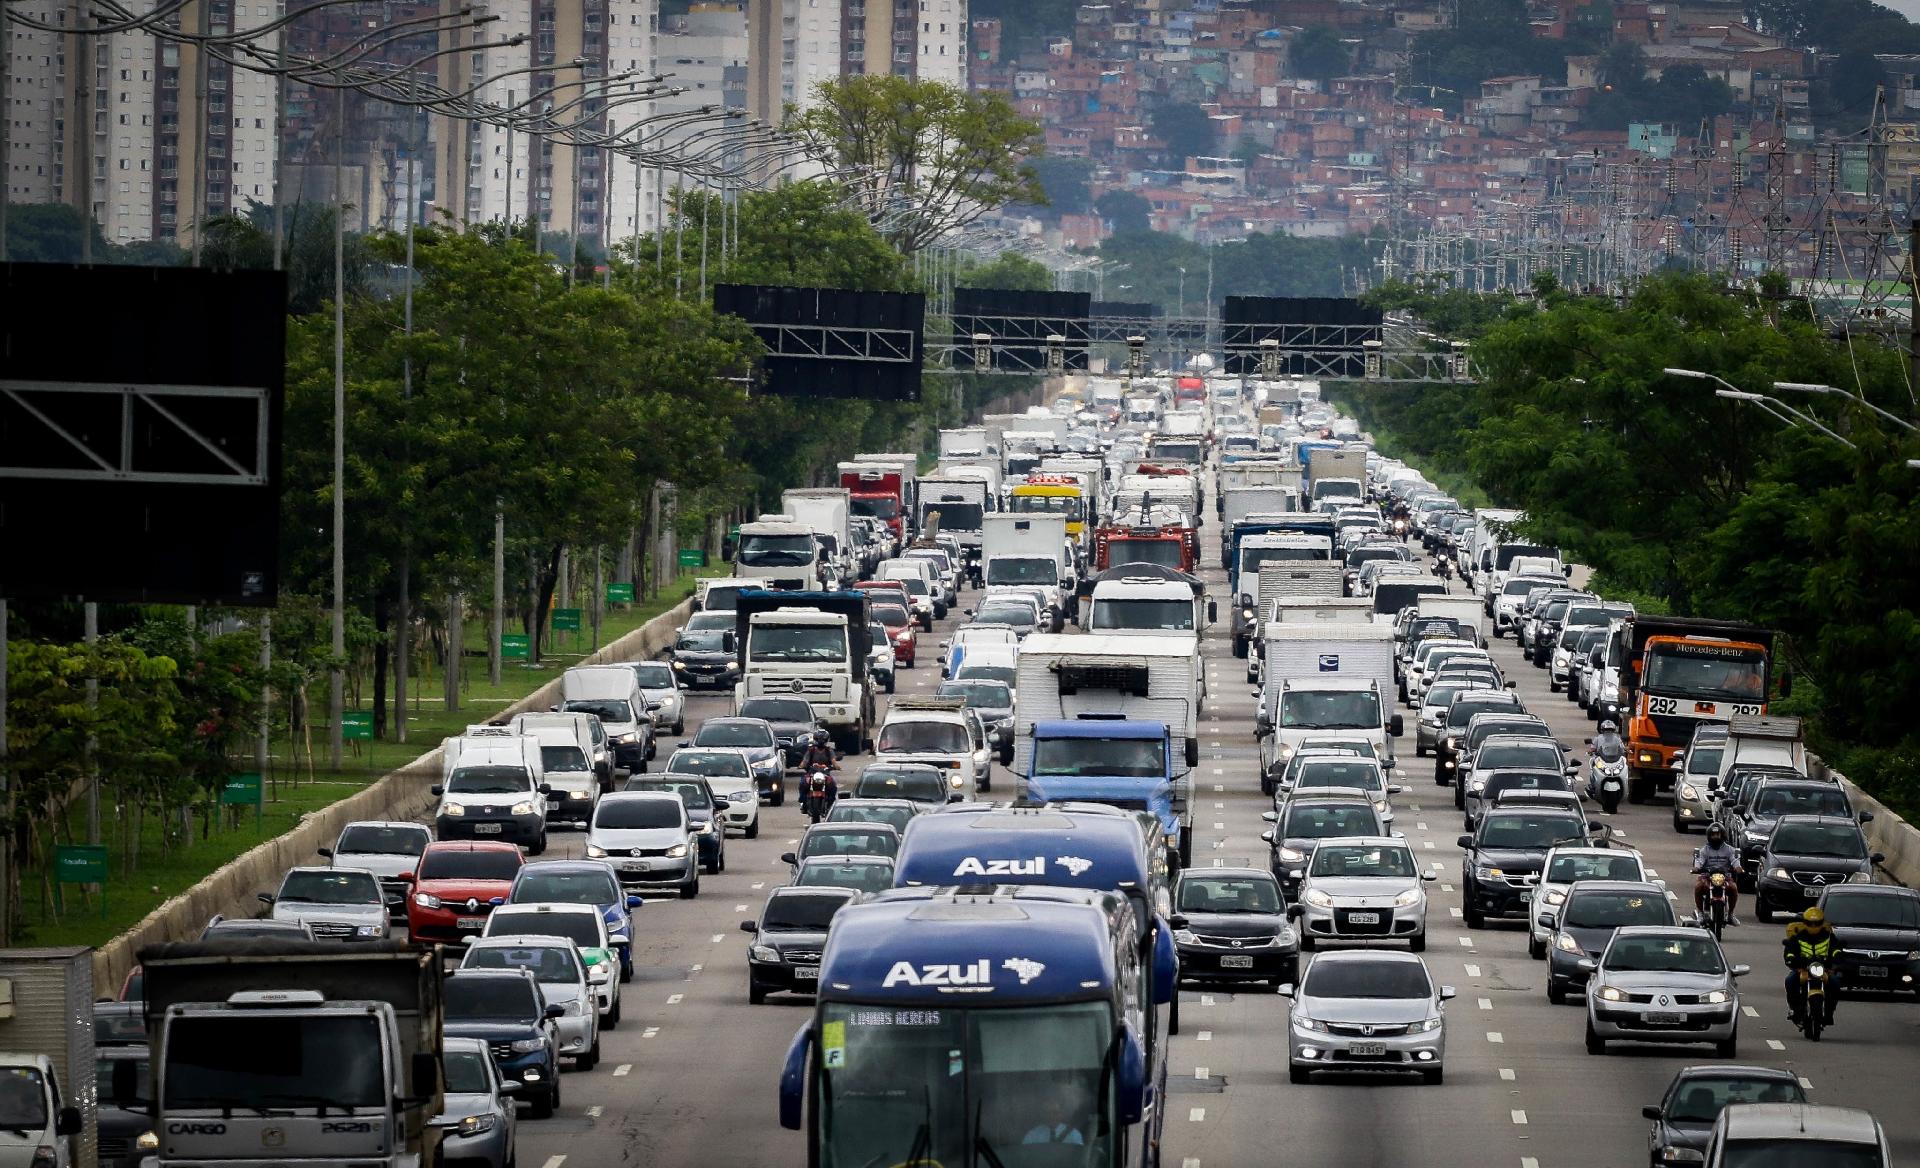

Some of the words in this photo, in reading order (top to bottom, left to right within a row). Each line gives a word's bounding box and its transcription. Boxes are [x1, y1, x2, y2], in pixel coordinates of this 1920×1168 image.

[1676, 644, 1743, 657] Mercedes-Benz
[1649, 698, 1677, 715] 292
[953, 856, 1045, 876] Azul
[882, 958, 991, 988] Azul
[850, 1012, 893, 1026] LINHAS
[828, 1051, 840, 1064] F
[168, 1123, 227, 1136] CARGO
